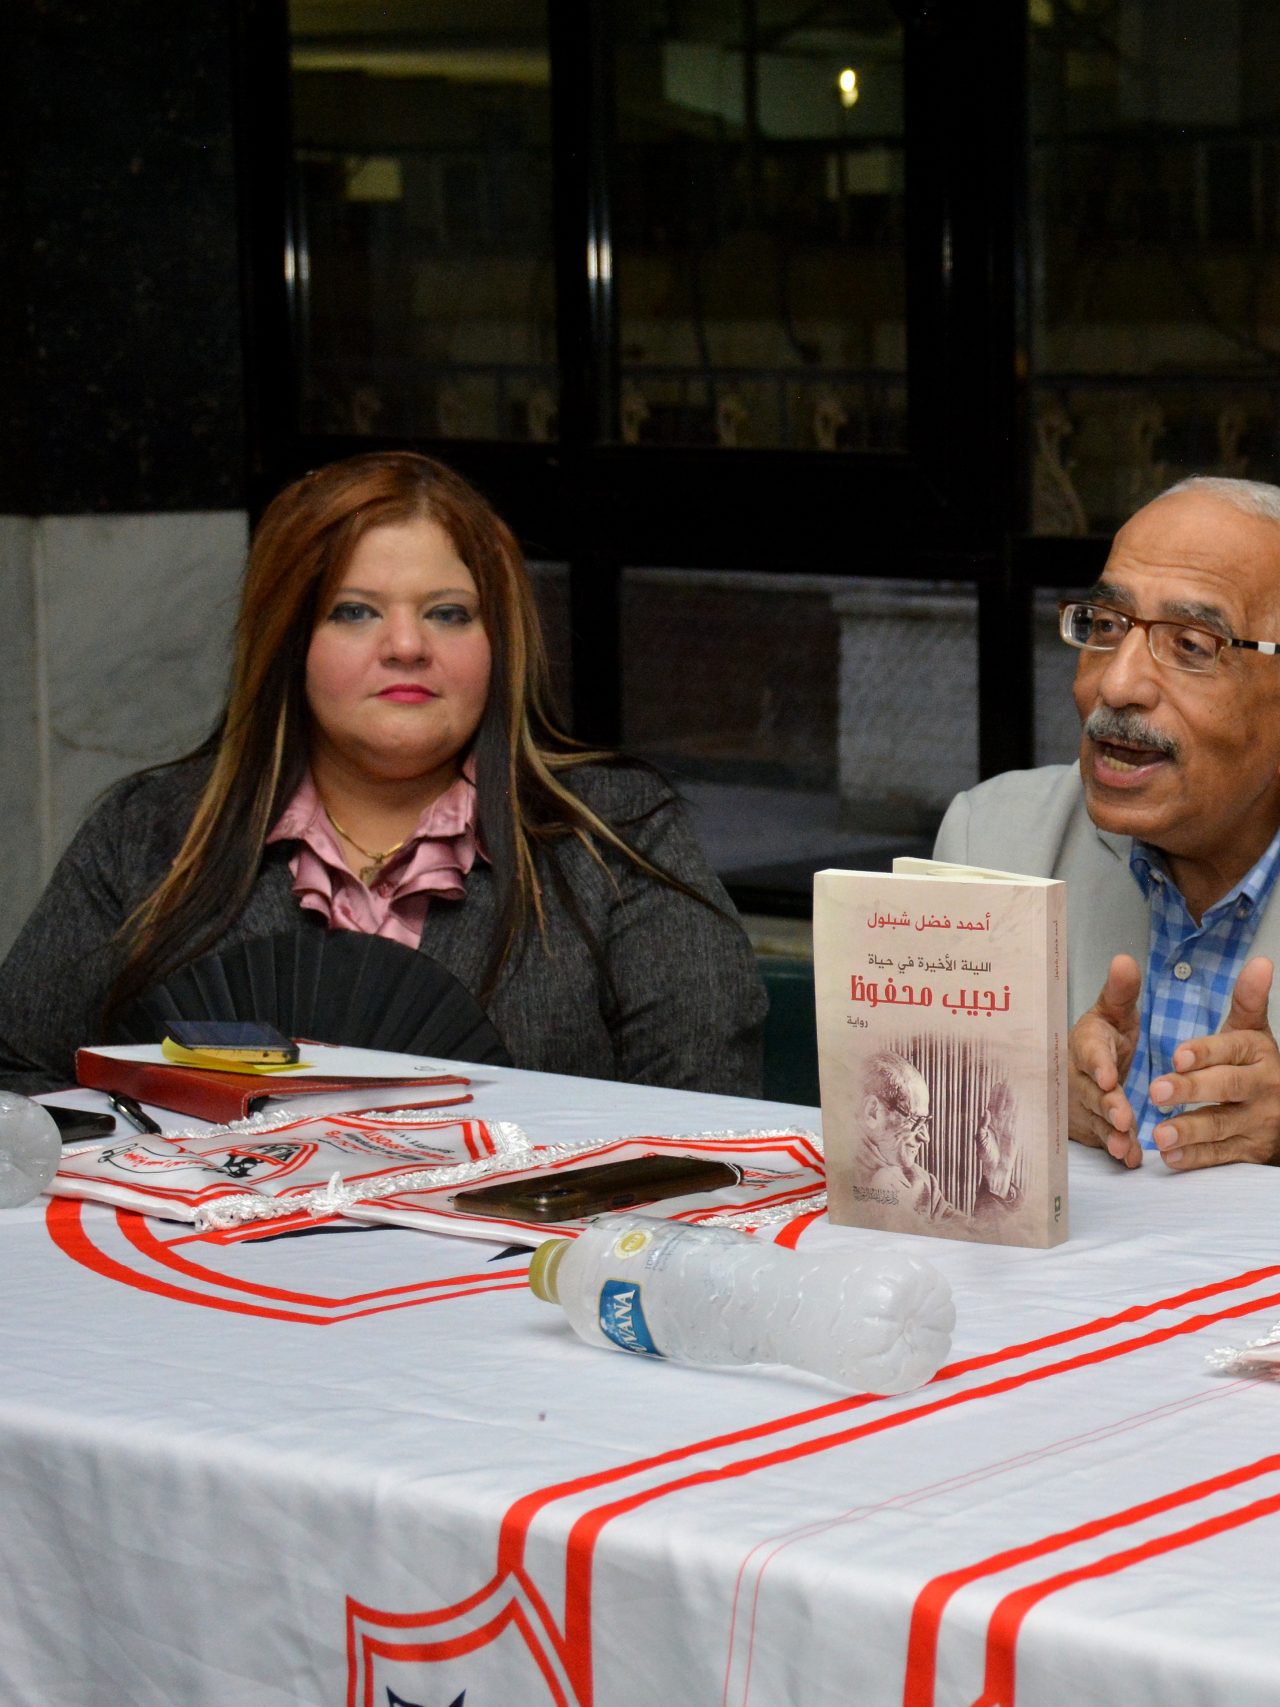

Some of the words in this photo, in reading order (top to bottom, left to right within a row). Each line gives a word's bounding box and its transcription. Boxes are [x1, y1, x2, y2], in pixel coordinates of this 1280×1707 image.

[867, 911, 911, 930] شبلول
[915, 914, 952, 932] فضل
[956, 912, 992, 931] أحمد
[868, 953, 894, 969] حياة
[897, 956, 915, 974] في
[917, 954, 957, 973] الأخيرة
[960, 959, 992, 975] الليلة
[850, 974, 933, 1008] محفوظ
[942, 985, 1011, 1018] نجيب
[846, 1015, 869, 1028] رواية
